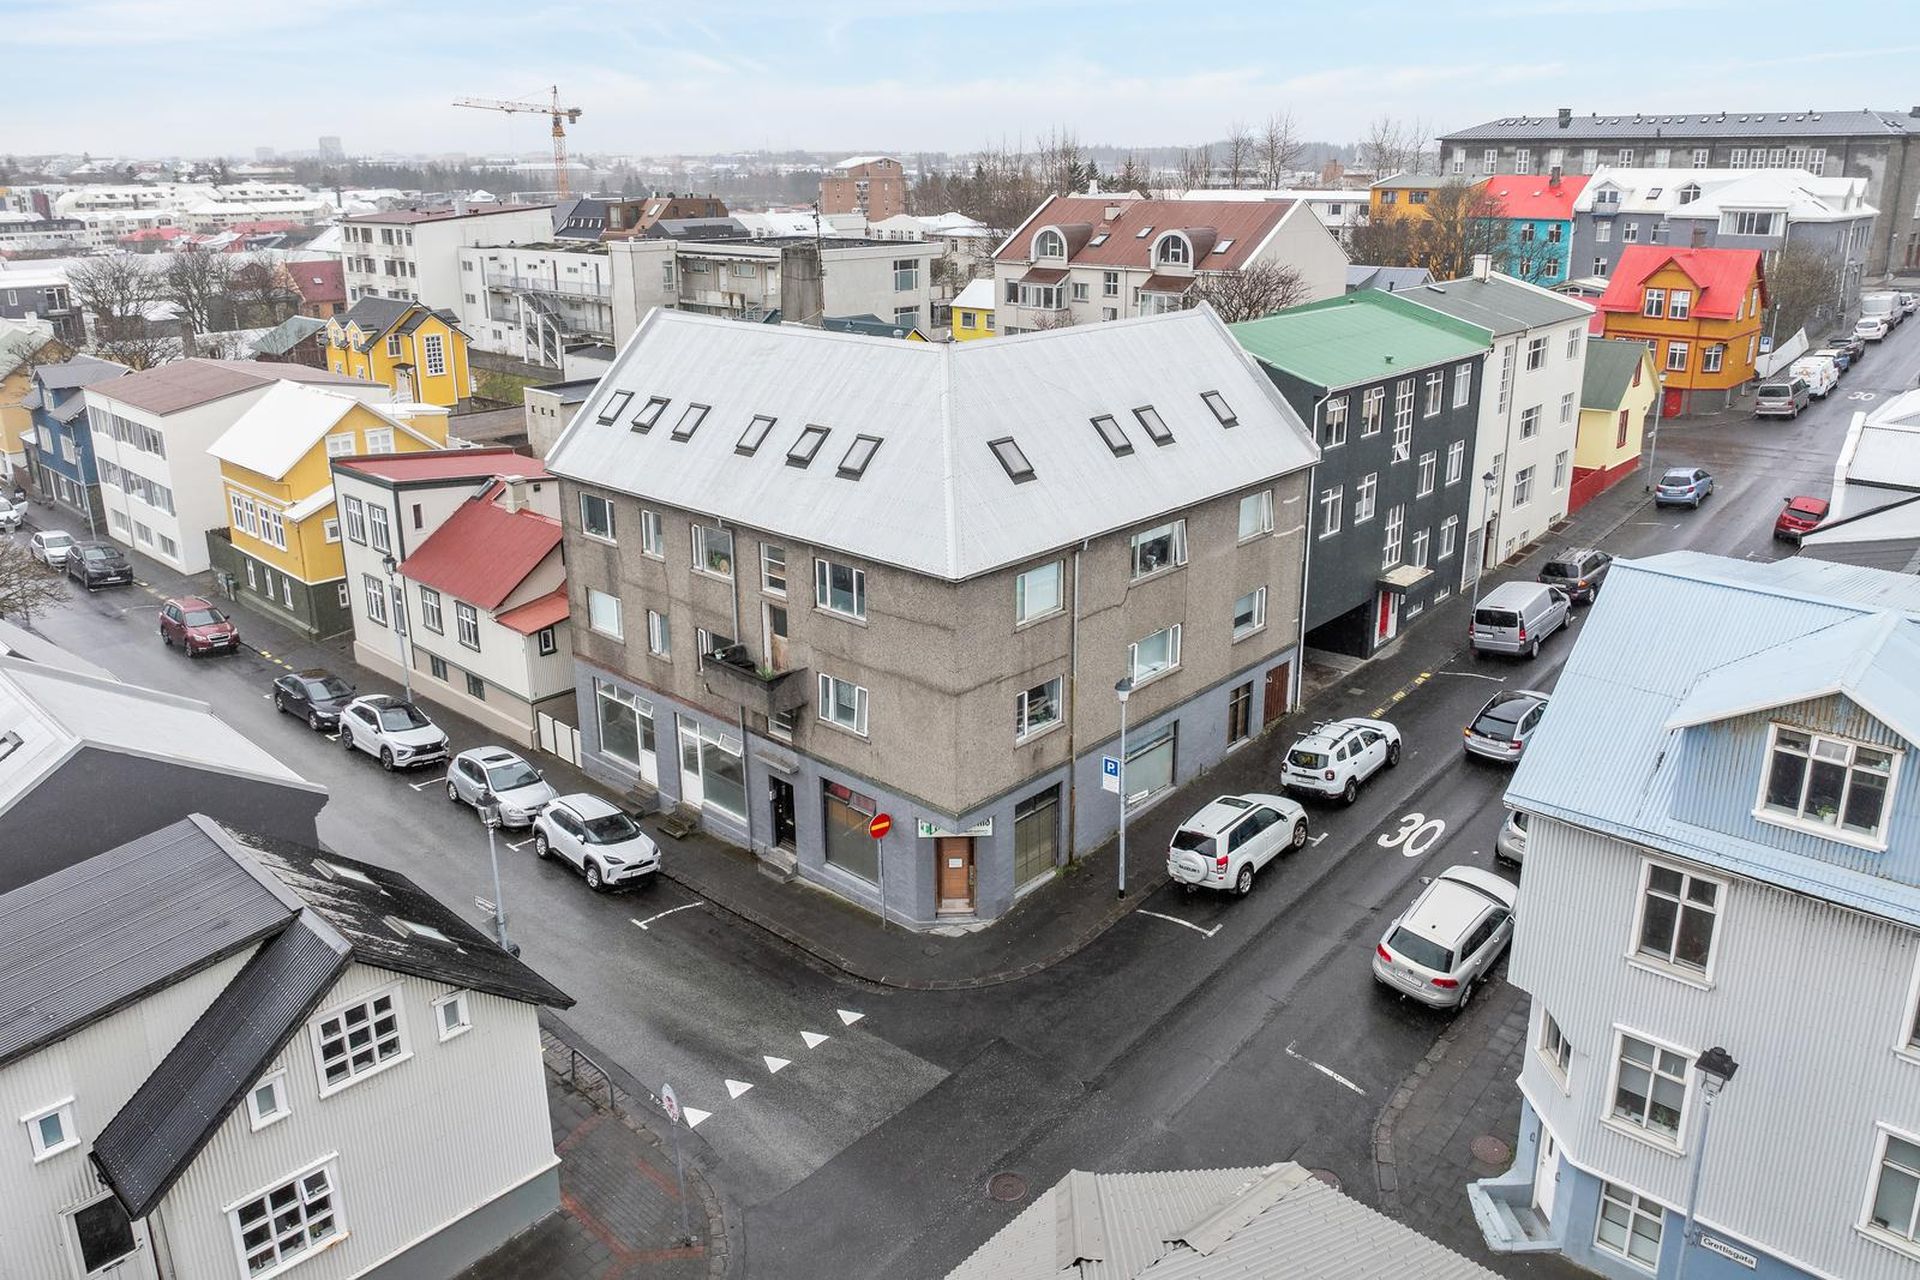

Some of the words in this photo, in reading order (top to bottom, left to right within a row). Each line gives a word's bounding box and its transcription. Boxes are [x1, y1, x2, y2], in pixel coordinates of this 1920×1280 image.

[1847, 391, 1875, 401] 30
[1107, 762, 1115, 772] P
[1377, 812, 1446, 858] 30
[1703, 1237, 1754, 1265] Grettisgata
